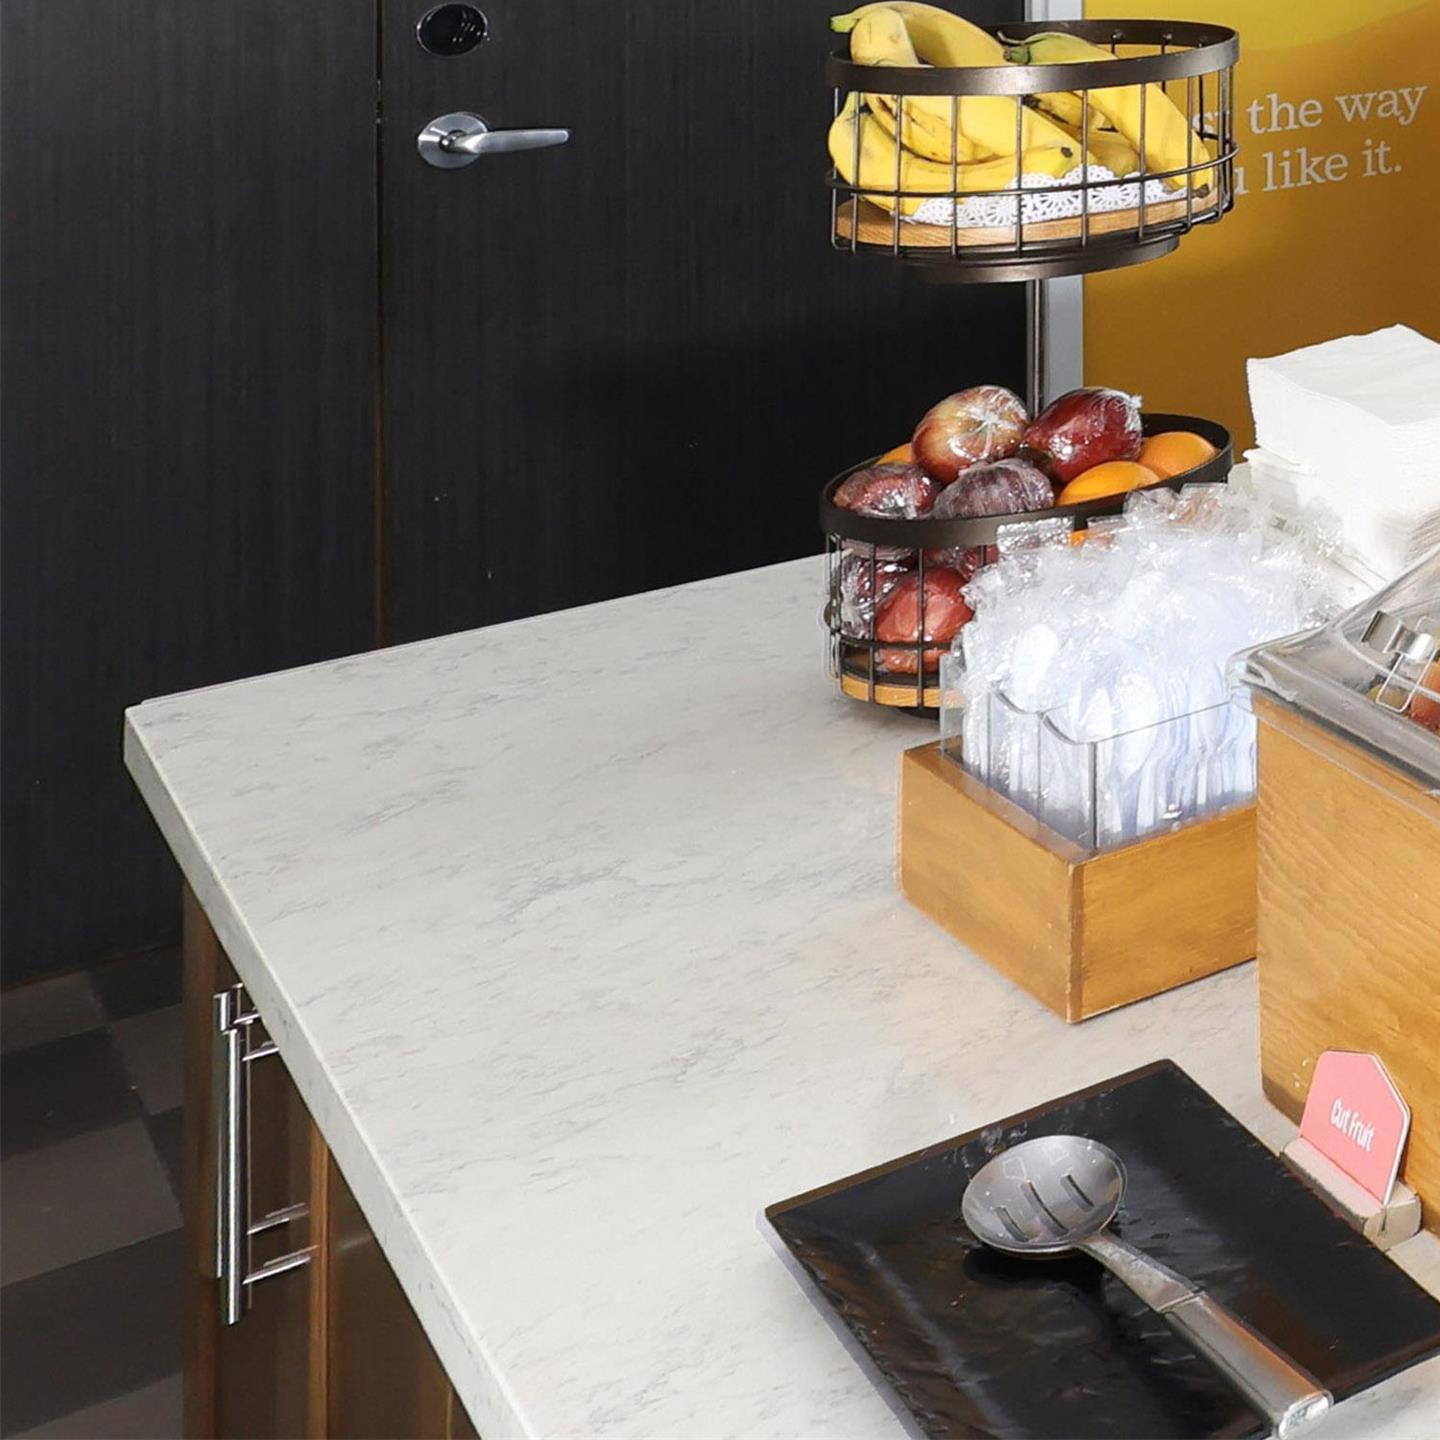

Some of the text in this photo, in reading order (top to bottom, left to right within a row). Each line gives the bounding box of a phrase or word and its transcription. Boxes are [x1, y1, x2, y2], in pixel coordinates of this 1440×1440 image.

[1246, 92, 1323, 135] the
[1335, 85, 1428, 126] way
[1263, 147, 1349, 192] like
[1361, 139, 1402, 177] it.
[1330, 1098, 1375, 1152] Cut Fruit
